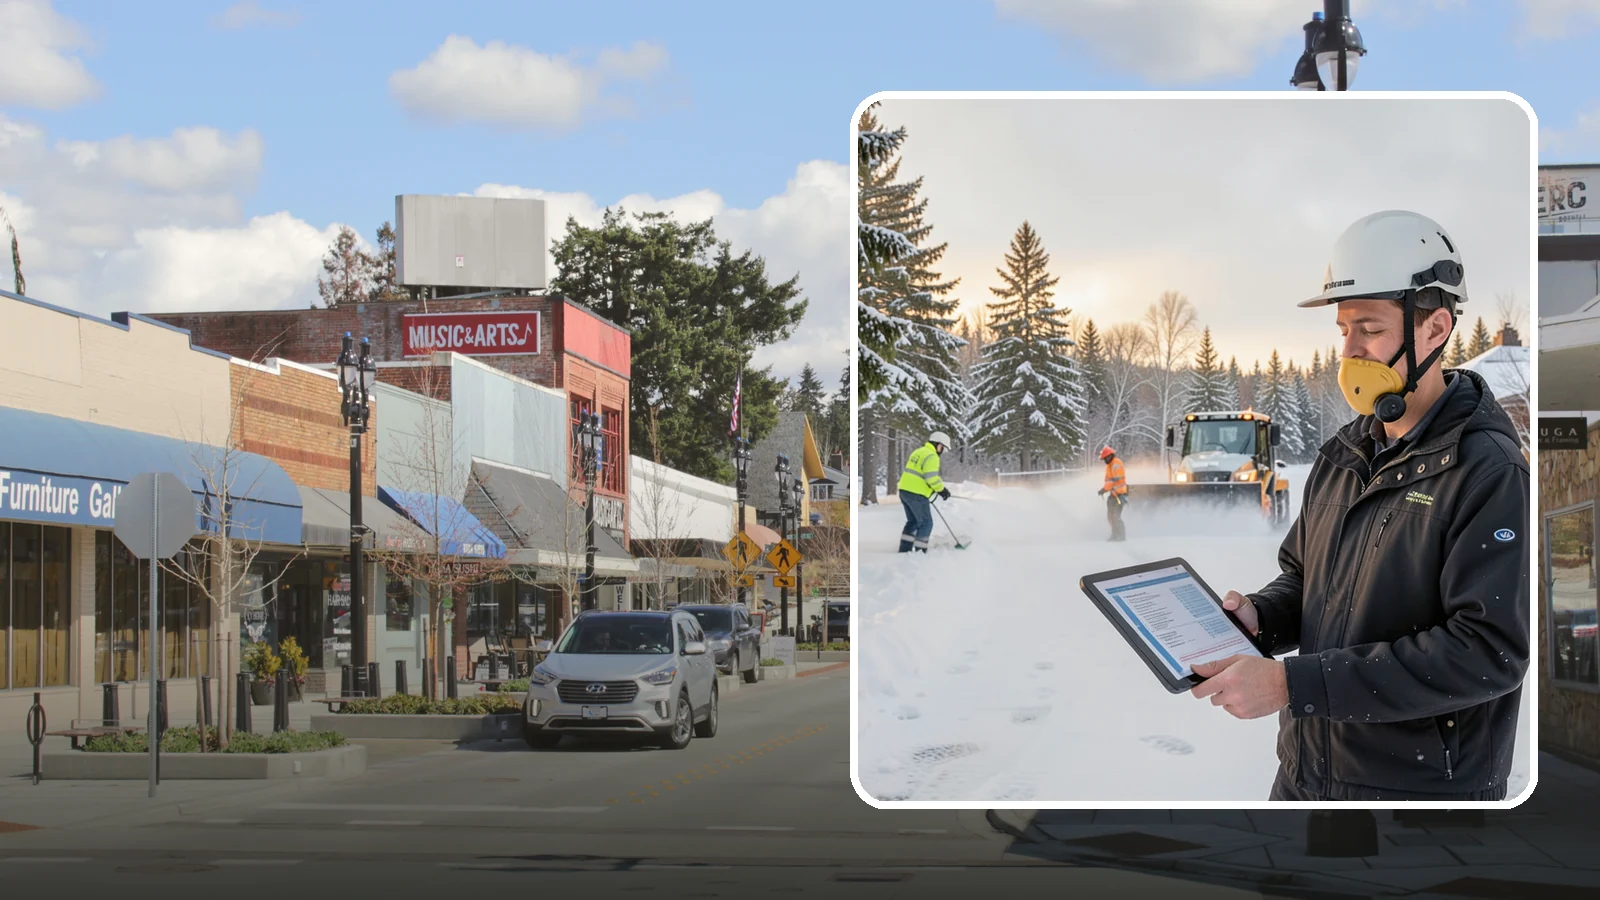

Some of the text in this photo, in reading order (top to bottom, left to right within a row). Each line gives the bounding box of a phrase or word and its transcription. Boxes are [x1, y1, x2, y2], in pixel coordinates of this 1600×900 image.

[0, 471, 121, 519] Furniture Gal
[453, 563, 479, 573] SUSHI
